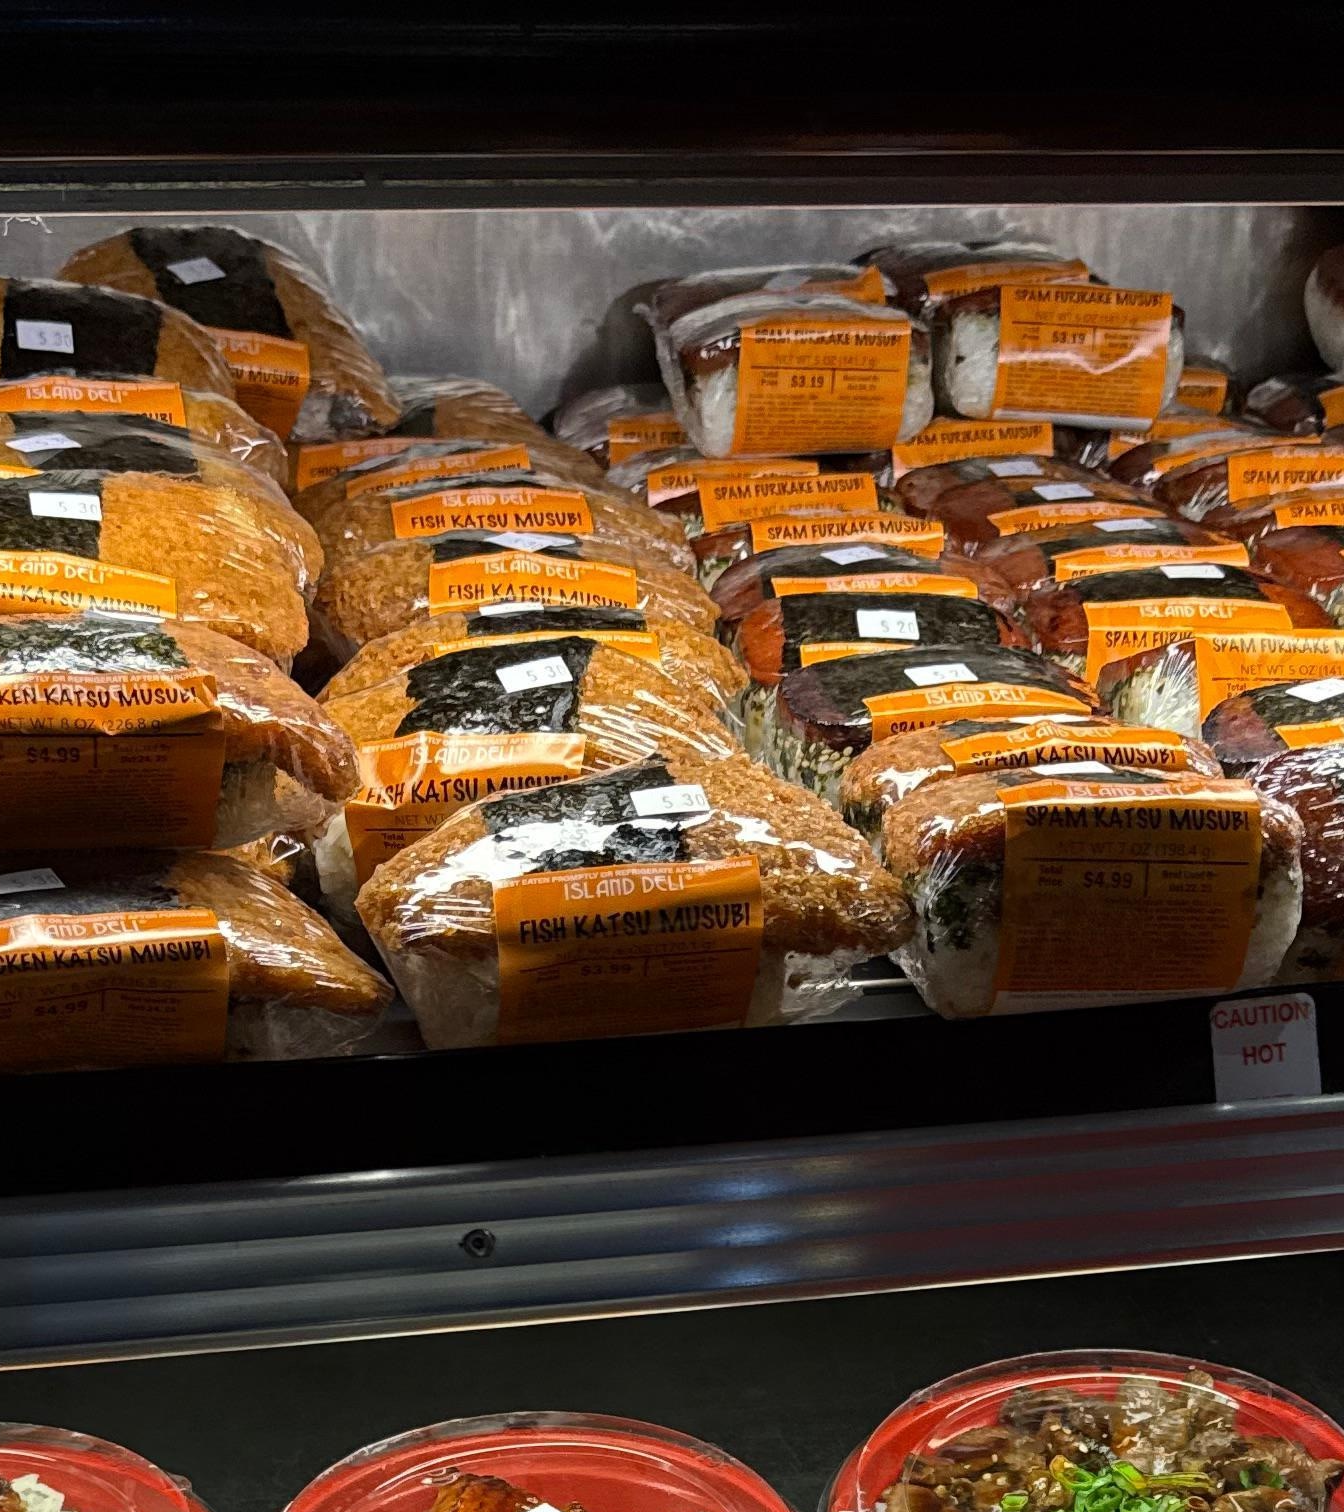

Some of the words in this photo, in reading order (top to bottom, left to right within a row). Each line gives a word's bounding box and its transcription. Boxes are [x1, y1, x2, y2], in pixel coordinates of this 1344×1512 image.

[714, 483, 751, 501] SPAM
[755, 480, 814, 499] FURIKAKE
[818, 478, 865, 495] MUSUBI
[411, 513, 447, 529] FISH
[451, 512, 508, 529] KATSU
[513, 512, 582, 528] MUSUBI
[1291, 502, 1327, 518] SPAM
[767, 525, 807, 541] SPAM
[811, 523, 874, 541] FURIKAKE
[879, 519, 933, 535] MUSUBI
[20, 583, 83, 608] KATSU
[1105, 631, 1149, 648] SPAM
[1213, 637, 1256, 653] SPAM
[1260, 636, 1330, 655] FURIKAKE
[1241, 664, 1262, 676] NET
[1265, 664, 1286, 676] WT
[45, 687, 110, 710] KATSU
[119, 686, 199, 708] MUSUBI
[26, 747, 81, 764] $4.99
[972, 749, 1030, 769] SPAM
[1036, 746, 1097, 764] KATSU
[1103, 747, 1177, 766] MUSUBI
[1025, 805, 1087, 829] SPAM
[1092, 806, 1162, 831] KATSU
[1169, 808, 1251, 831] MUSUBI
[519, 917, 567, 945] FISH
[573, 910, 653, 939] KATSU
[658, 903, 751, 934] MUSUBI
[53, 947, 123, 969] KATSU
[131, 941, 211, 966] MUSUBI
[1212, 1001, 1309, 1029] CAUTION
[1242, 1042, 1287, 1066] HOT
